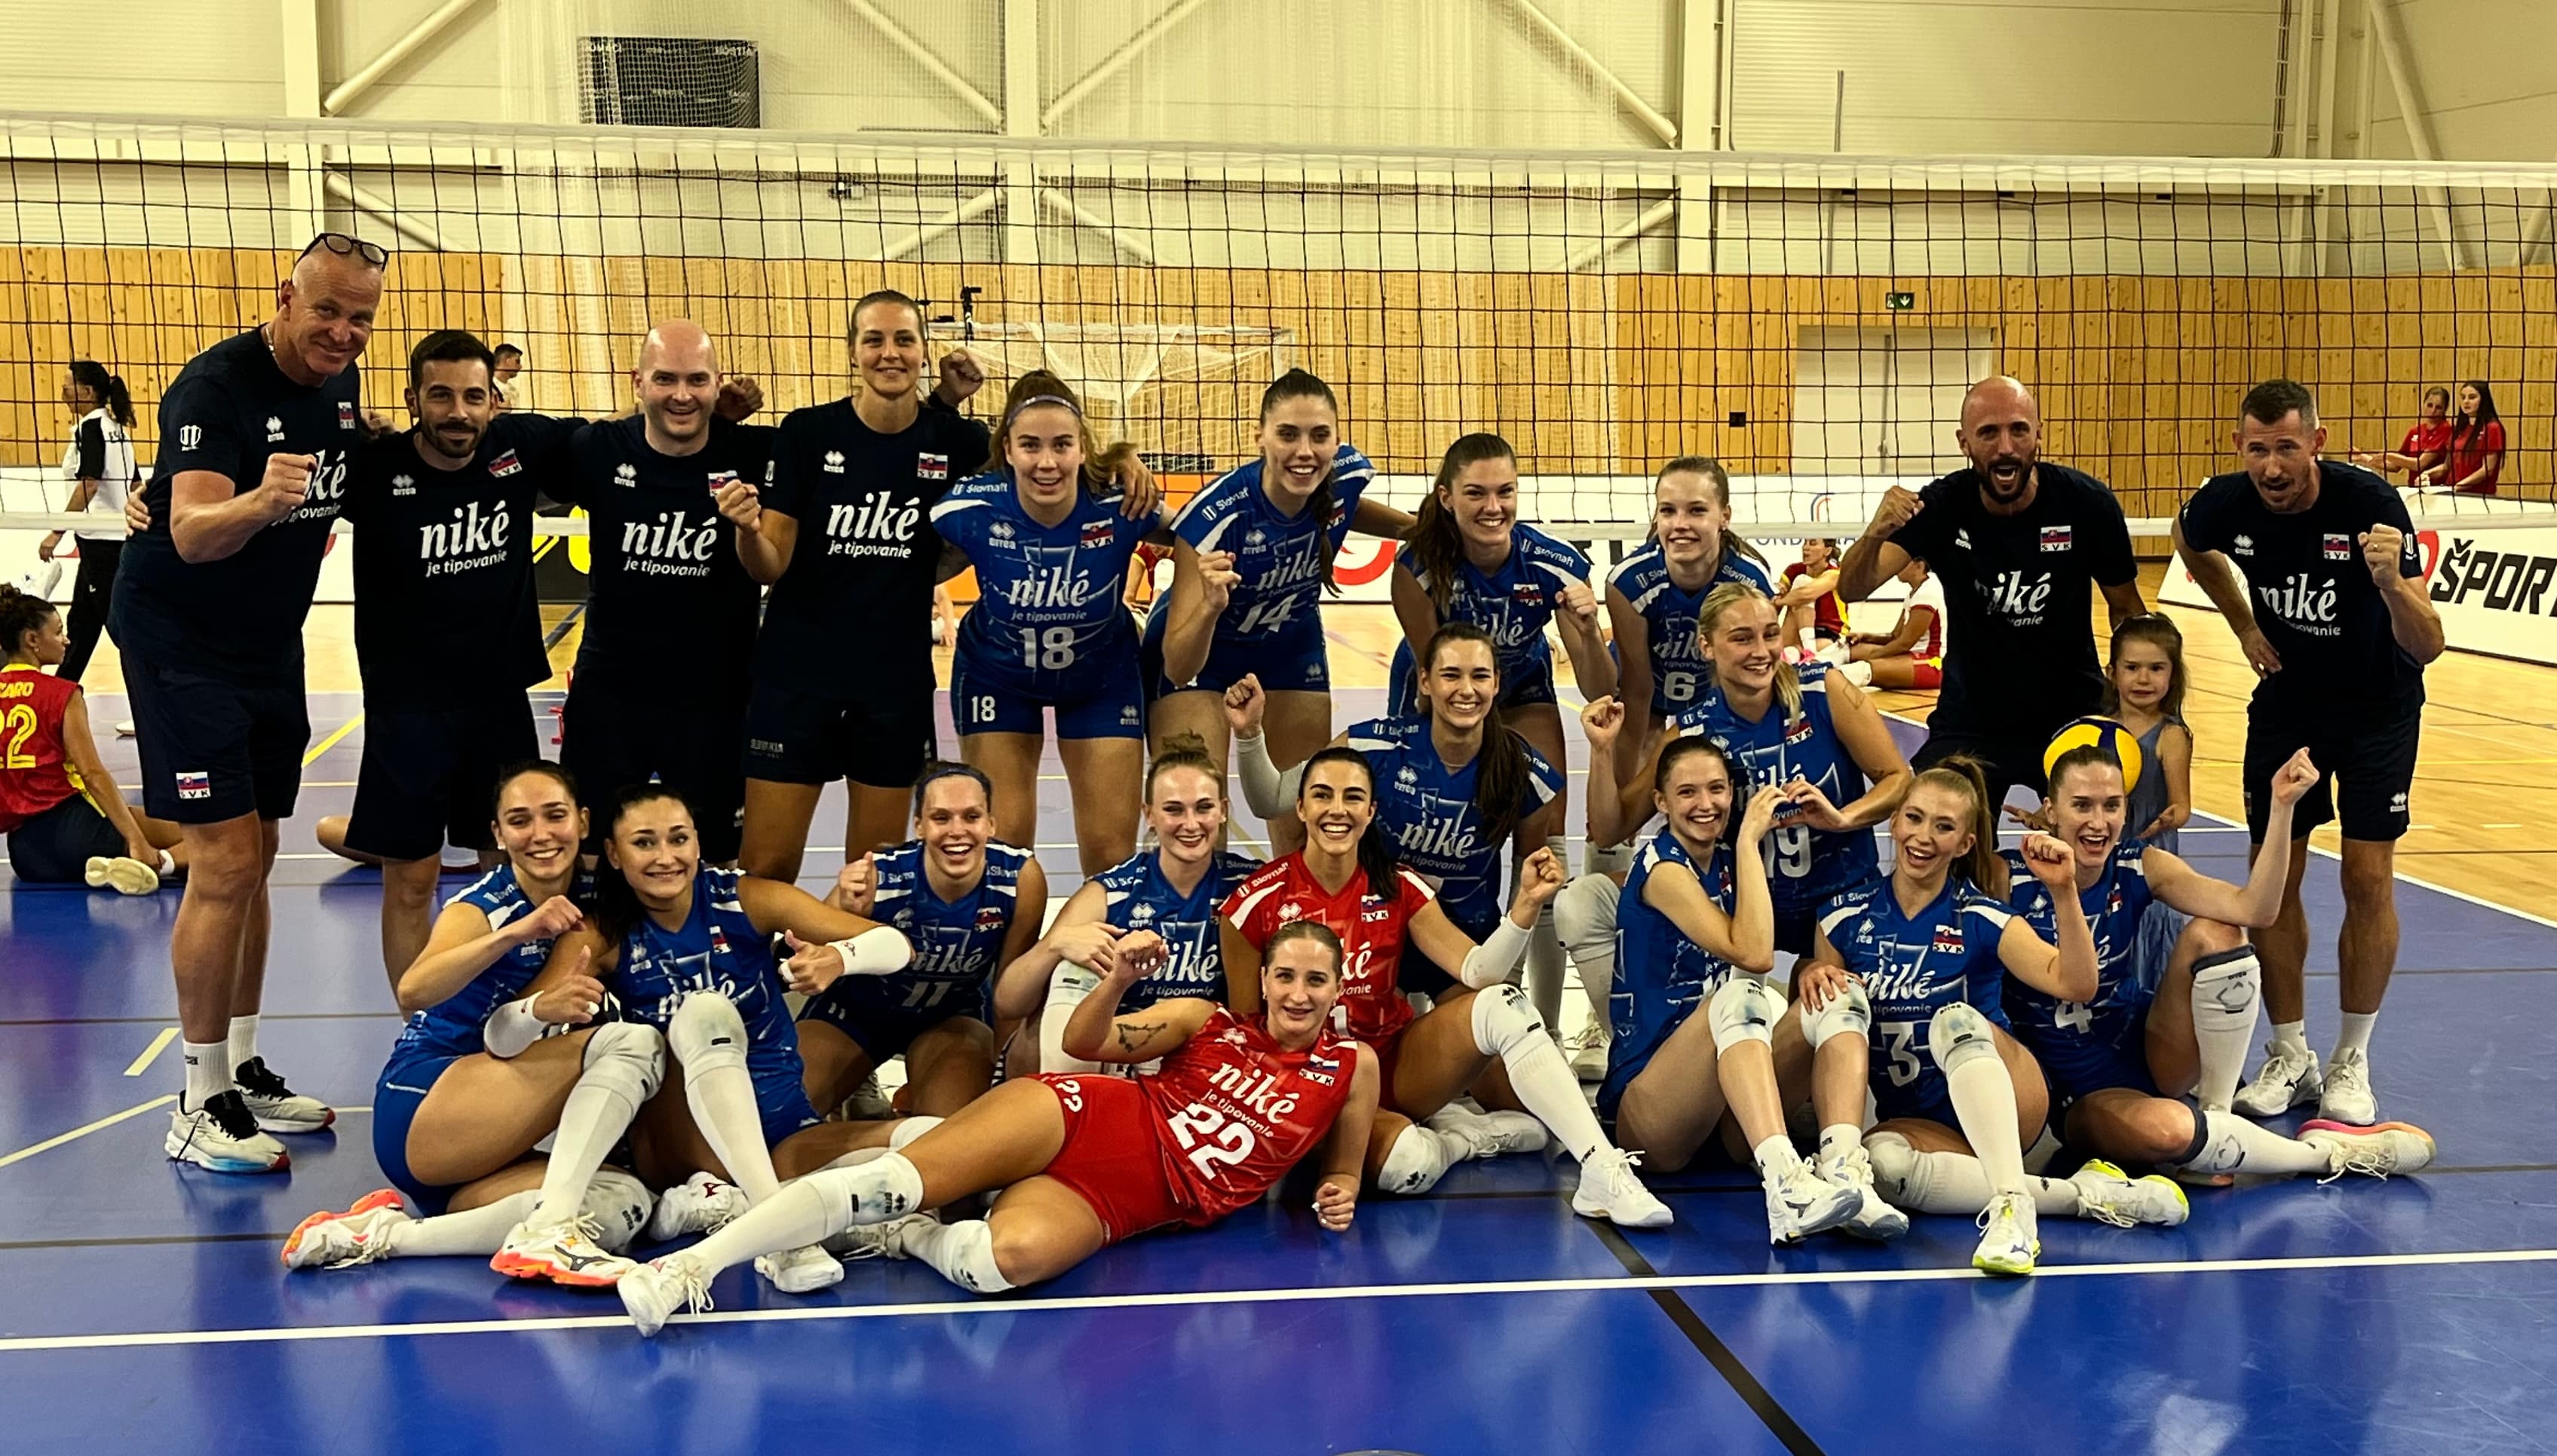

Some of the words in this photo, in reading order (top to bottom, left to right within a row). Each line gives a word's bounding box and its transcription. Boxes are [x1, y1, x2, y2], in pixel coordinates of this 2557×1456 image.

[303, 449, 347, 501] ké
[420, 500, 510, 559] niké
[621, 511, 717, 561] niké
[826, 491, 920, 541] niké
[425, 561, 440, 578] je
[443, 550, 507, 575] tipovanie
[624, 556, 639, 571] je
[641, 559, 710, 576] tipovanie
[827, 540, 842, 555] je
[845, 541, 911, 559] tipovanie
[1009, 567, 1090, 608] niké
[2258, 573, 2337, 622] niké
[2430, 538, 2557, 618] ŠPOR
[1011, 610, 1023, 621] je
[1026, 610, 1087, 622] tipovanie
[1237, 594, 1298, 633] 14
[1019, 627, 1075, 670] 18
[1664, 671, 1696, 701] 6
[971, 695, 996, 723] 18
[0, 703, 37, 770] 2
[1399, 817, 1476, 859] niké
[901, 981, 953, 1007] 11
[1141, 984, 1154, 997] je
[1859, 962, 1936, 1001] niké
[1881, 1021, 1921, 1087] 3
[1056, 1078, 1084, 1113] 22
[1203, 1089, 1218, 1102] je
[1216, 1098, 1274, 1139] tipovanie
[1209, 1062, 1297, 1125] niké
[1168, 1102, 1256, 1181] 22
